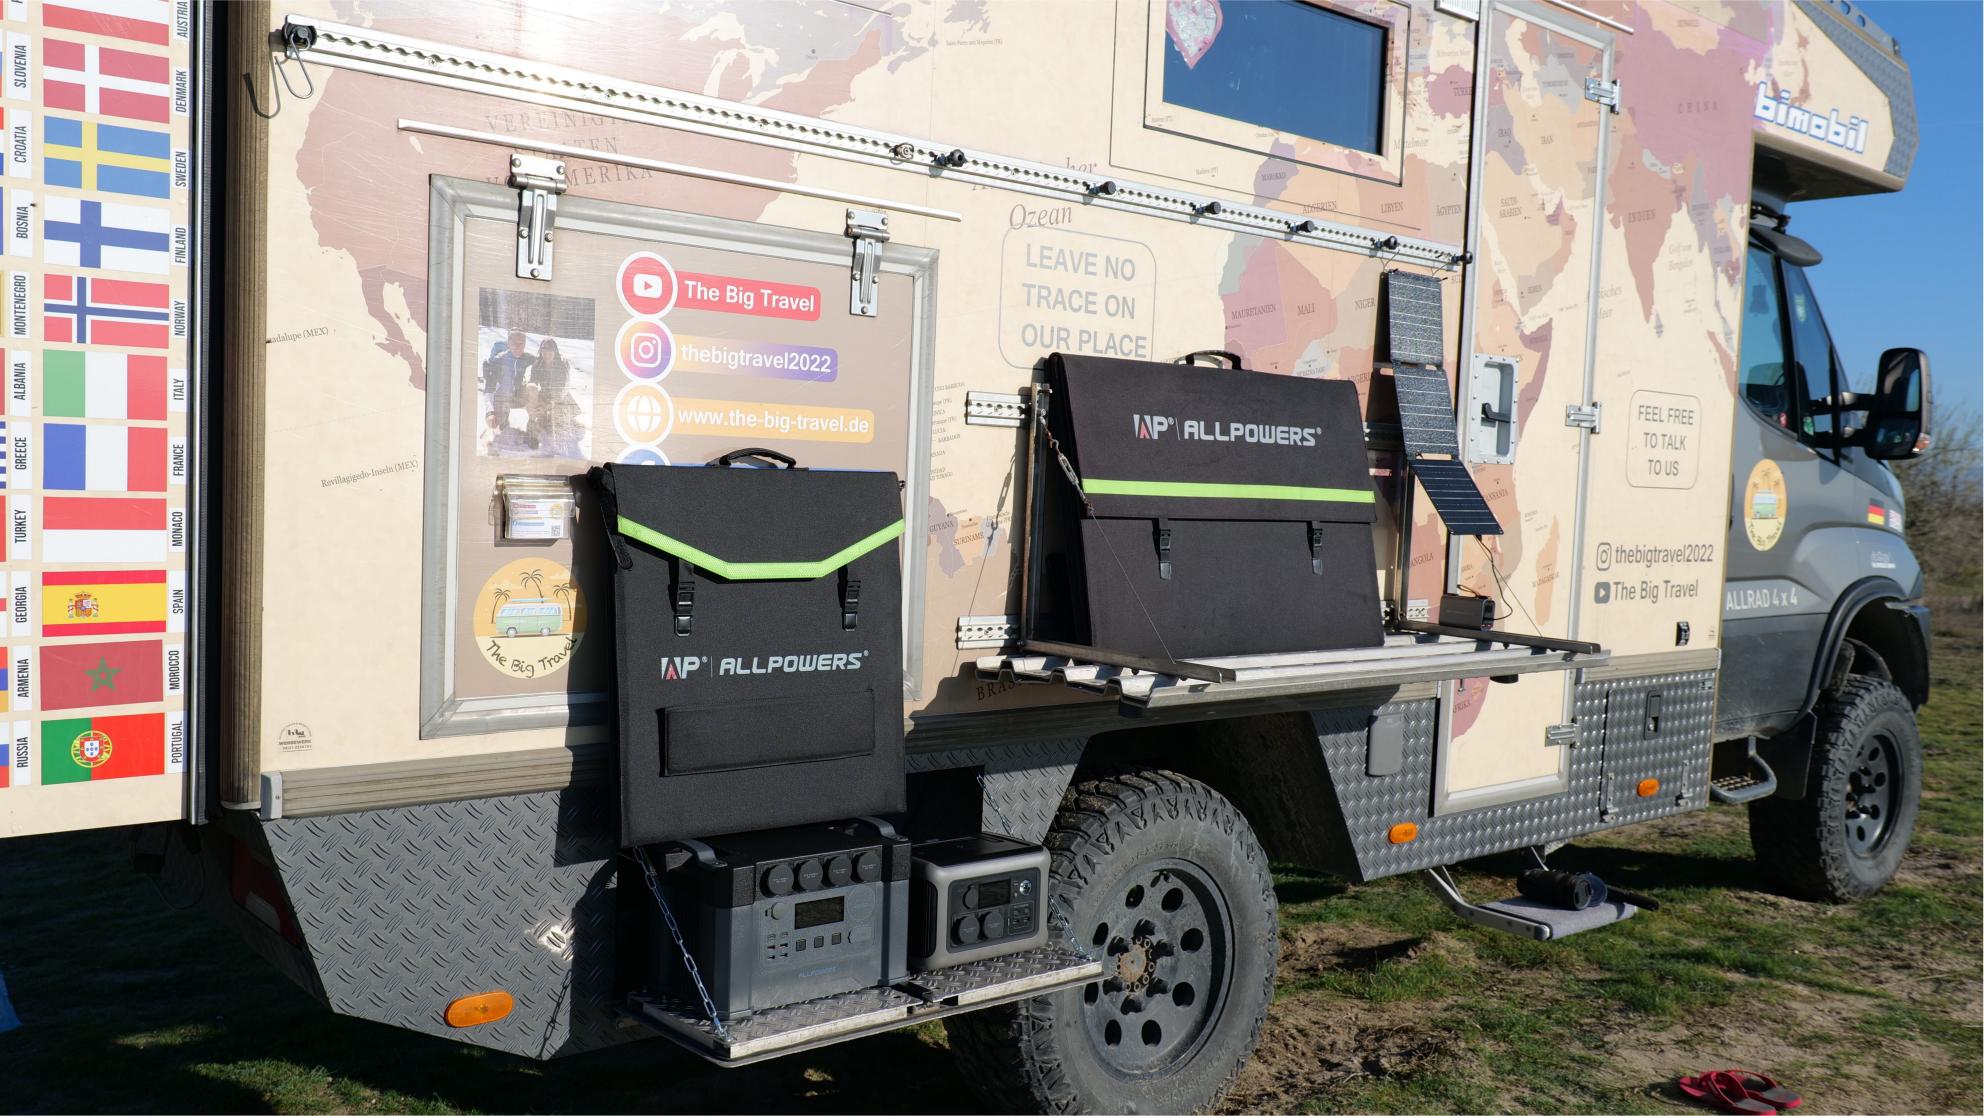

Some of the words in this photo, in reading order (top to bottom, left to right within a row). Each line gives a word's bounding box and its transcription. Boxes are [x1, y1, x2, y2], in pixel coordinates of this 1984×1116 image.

[177, 1, 188, 38] AUSTRIA
[14, 45, 26, 88] SLOVENIA
[176, 69, 188, 113] DENMARK
[485, 111, 629, 134] VEREINIG
[1754, 81, 1868, 153] bimobil
[14, 126, 27, 163] CROATIA
[176, 151, 187, 187] SWEDEN
[565, 164, 654, 187] MERIKA
[16, 206, 29, 239] BOSNIA
[1010, 203, 1072, 230] Ozean
[1302, 201, 1337, 214] ALGERIEN
[1381, 201, 1404, 214] LIBYEN
[175, 227, 186, 264] FINLAND
[1026, 243, 1097, 276] LEAVE
[1105, 255, 1136, 281] NO
[15, 274, 26, 335] MONTENEGRO
[684, 280, 719, 301] The
[725, 285, 754, 309] Big
[760, 289, 815, 312] Travel
[1022, 283, 1097, 316] TRACE
[1105, 294, 1135, 320] ON
[1297, 303, 1316, 316] MALI
[174, 300, 185, 336] NORWAY
[303, 326, 329, 339] (MEX)
[1021, 323, 1071, 351] OUR
[1078, 329, 1147, 359] PLACE
[681, 344, 832, 373] thebigtravel2022
[14, 362, 26, 400] ALBANIA
[173, 378, 184, 401] ITALY
[678, 409, 869, 433] www.the-big-travel.de
[1638, 405, 1664, 423] FEEL
[1668, 408, 1694, 425] FREE
[15, 436, 27, 470] GREECE
[1643, 432, 1658, 448] TO
[1661, 434, 1687, 451] TALK
[173, 443, 184, 477] FRANCE
[394, 459, 418, 473] (MEX)
[1648, 459, 1661, 475] TO
[1665, 460, 1679, 476] US
[15, 509, 27, 544] TURKEY
[172, 511, 183, 547] MONACO
[953, 532, 984, 545] SURINAME
[1615, 544, 1714, 568] thebigtravel2022
[15, 586, 27, 623] GEORGIA
[172, 589, 183, 614] SPAIN
[1613, 581, 1636, 601] The
[1640, 580, 1659, 602] Big
[1663, 579, 1698, 598] Travel
[1726, 588, 1770, 611] ALLRAD
[1772, 588, 1779, 607] 4
[1780, 592, 1787, 606] x
[1790, 587, 1798, 606] 4
[169, 650, 180, 690] MOROCCO
[486, 640, 507, 667] The
[511, 659, 535, 678] Big
[538, 636, 578, 670] Travel
[17, 658, 30, 698] ARMENIA
[16, 736, 29, 769] RUSSIA
[171, 720, 183, 763] PORTUGAL
